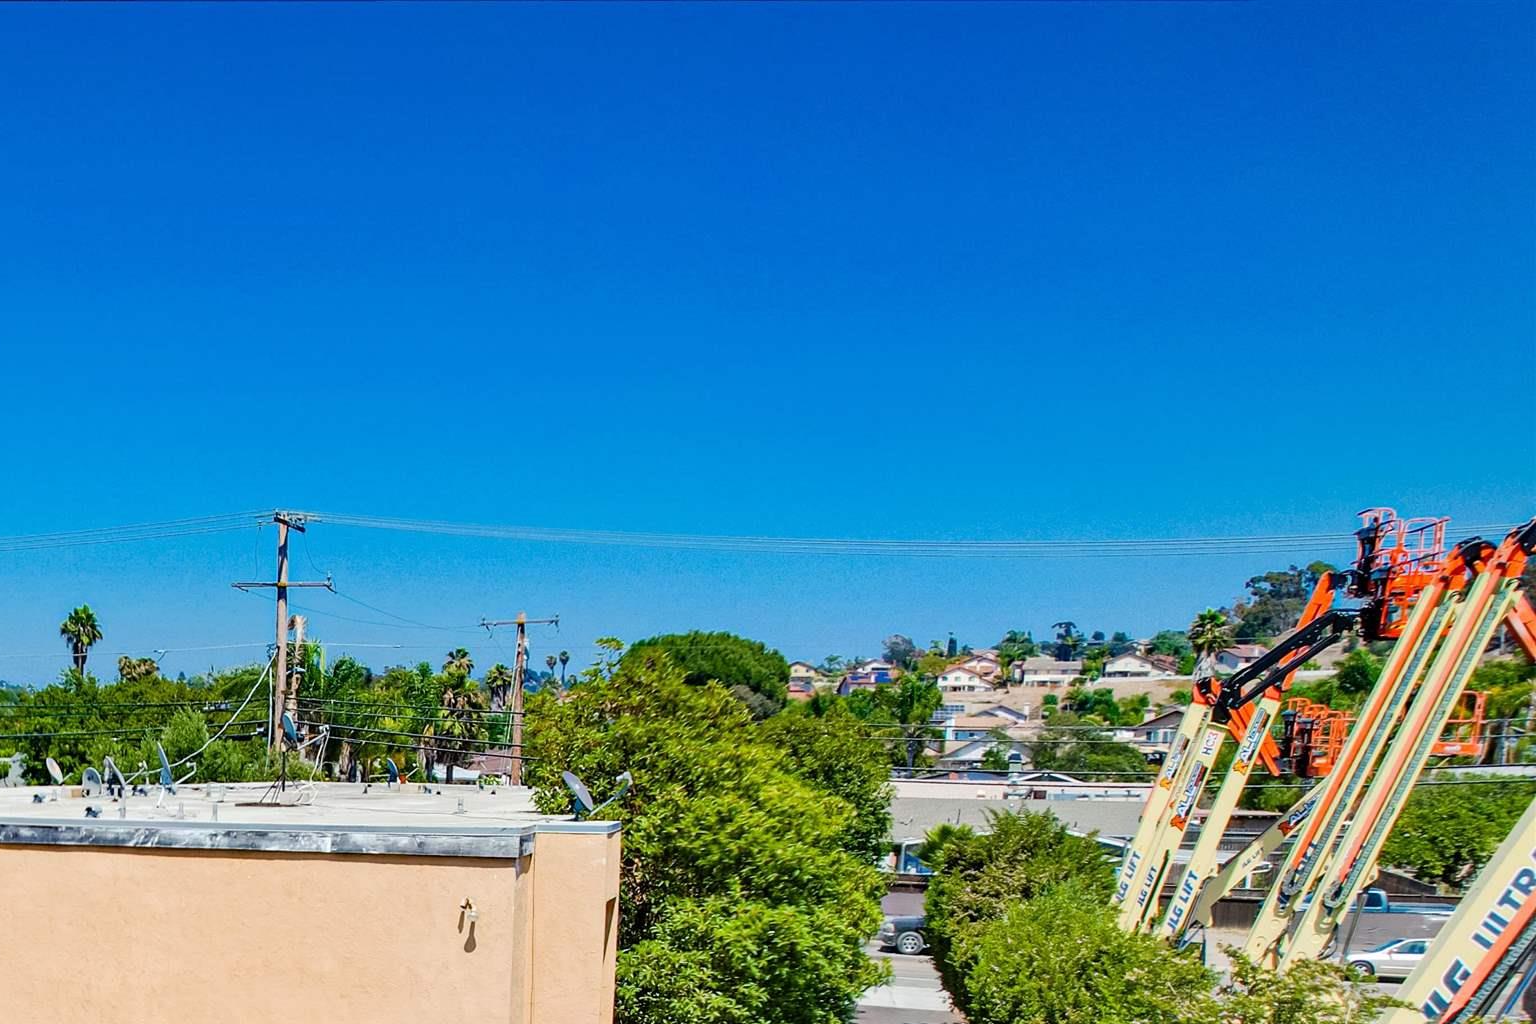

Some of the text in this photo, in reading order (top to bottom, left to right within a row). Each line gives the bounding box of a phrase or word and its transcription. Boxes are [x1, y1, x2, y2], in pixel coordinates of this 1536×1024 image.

[1124, 850, 1142, 880] LIFT
[1137, 866, 1158, 908] JLG LIFT
[1167, 869, 1199, 934] JLG LIFT
[1471, 846, 1536, 951] ULTR
